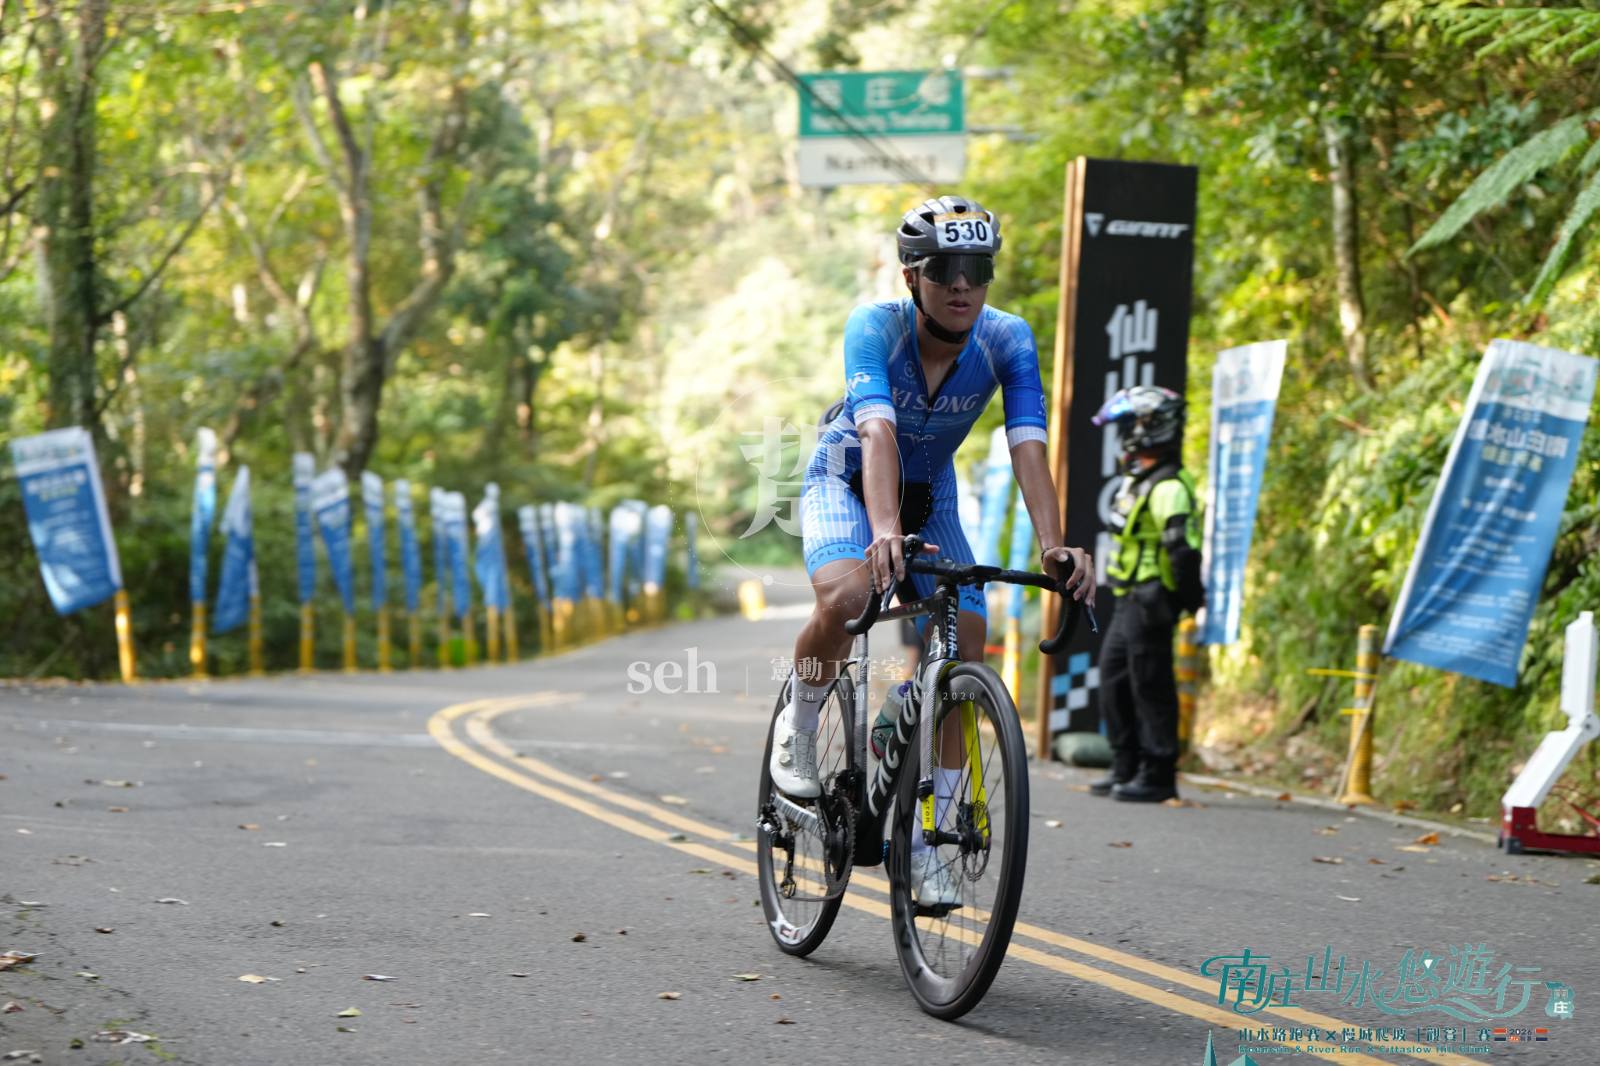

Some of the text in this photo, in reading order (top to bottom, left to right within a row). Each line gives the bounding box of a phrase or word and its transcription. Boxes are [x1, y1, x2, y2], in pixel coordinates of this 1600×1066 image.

[945, 221, 987, 242] 530
[1106, 219, 1189, 239] GIANT
[947, 595, 958, 656] FACTOR
